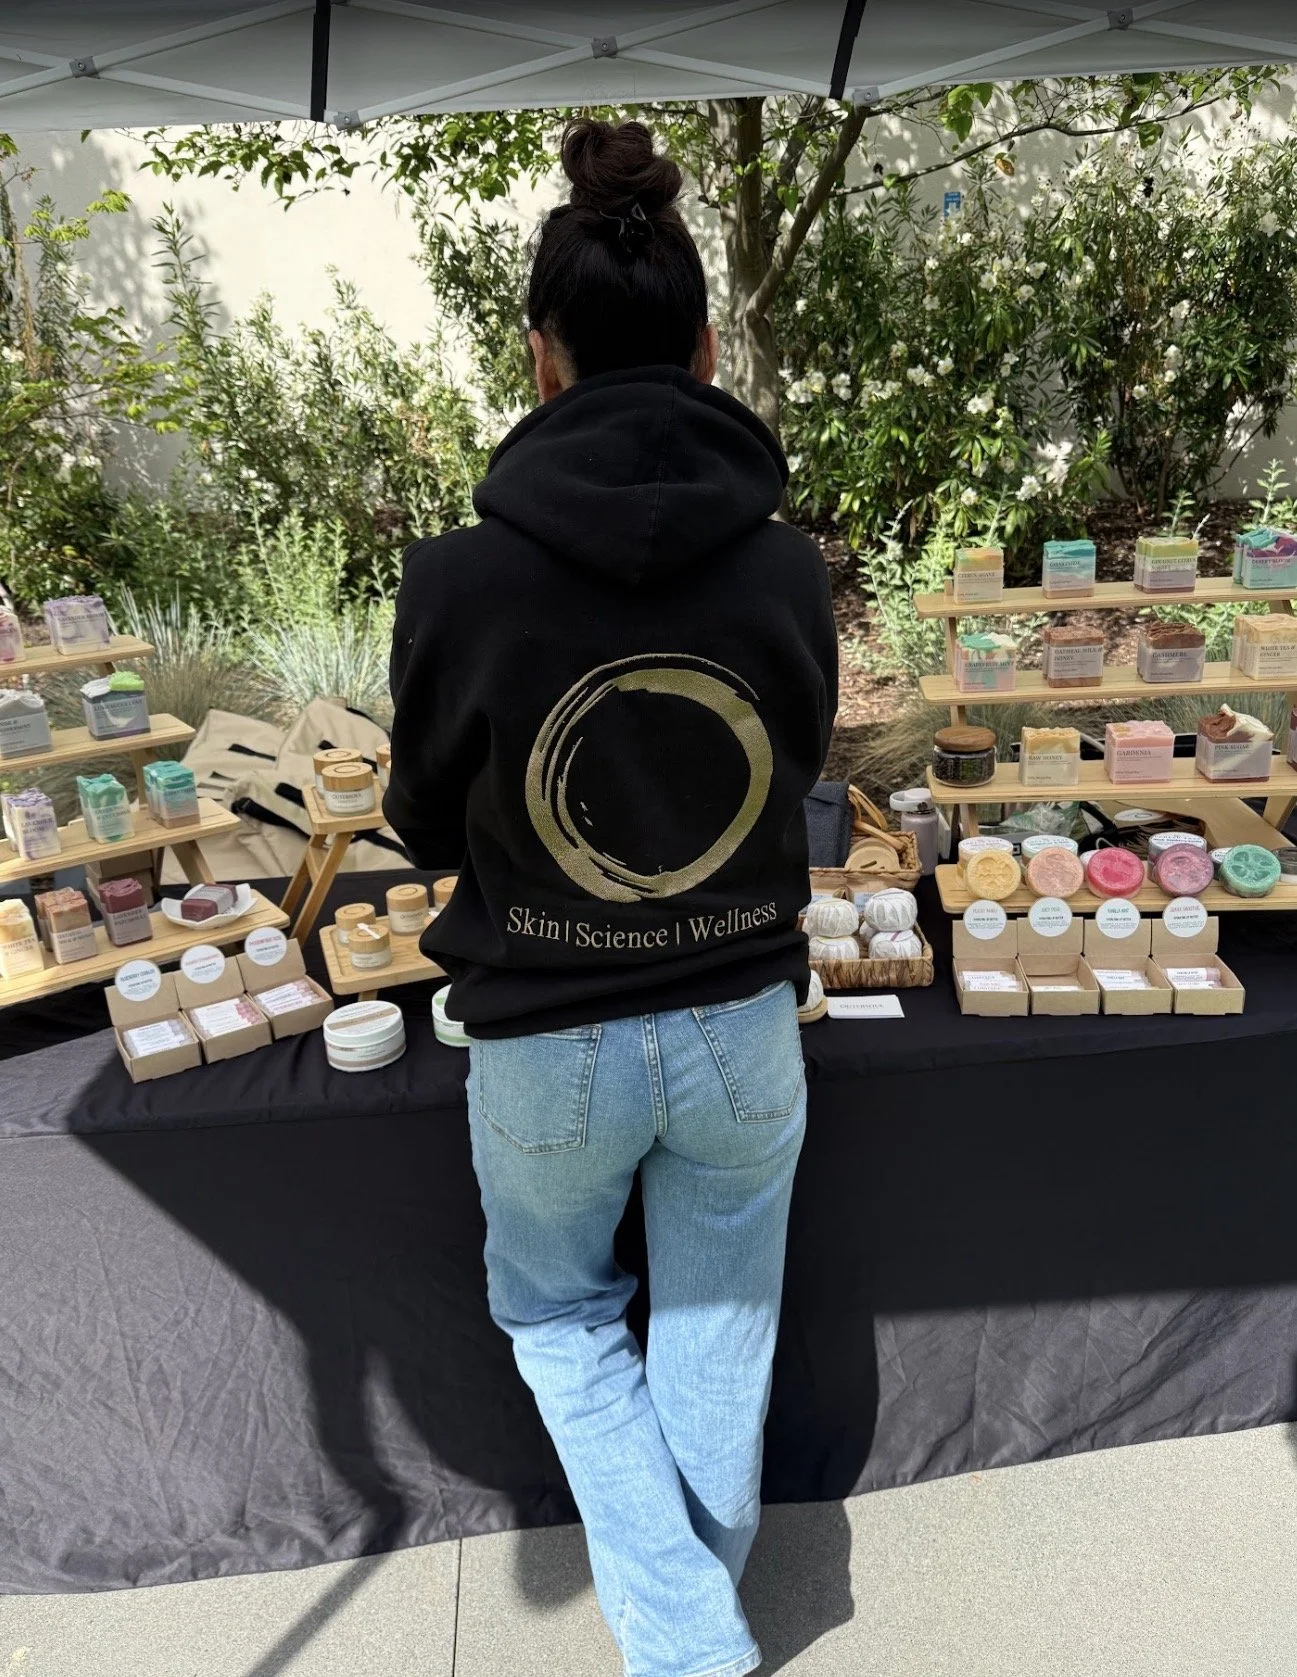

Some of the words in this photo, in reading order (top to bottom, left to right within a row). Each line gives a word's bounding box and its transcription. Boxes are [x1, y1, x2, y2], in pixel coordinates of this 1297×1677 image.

[507, 906, 560, 940] Skin
[575, 922, 668, 949] Science
[688, 902, 778, 942] Wellness
